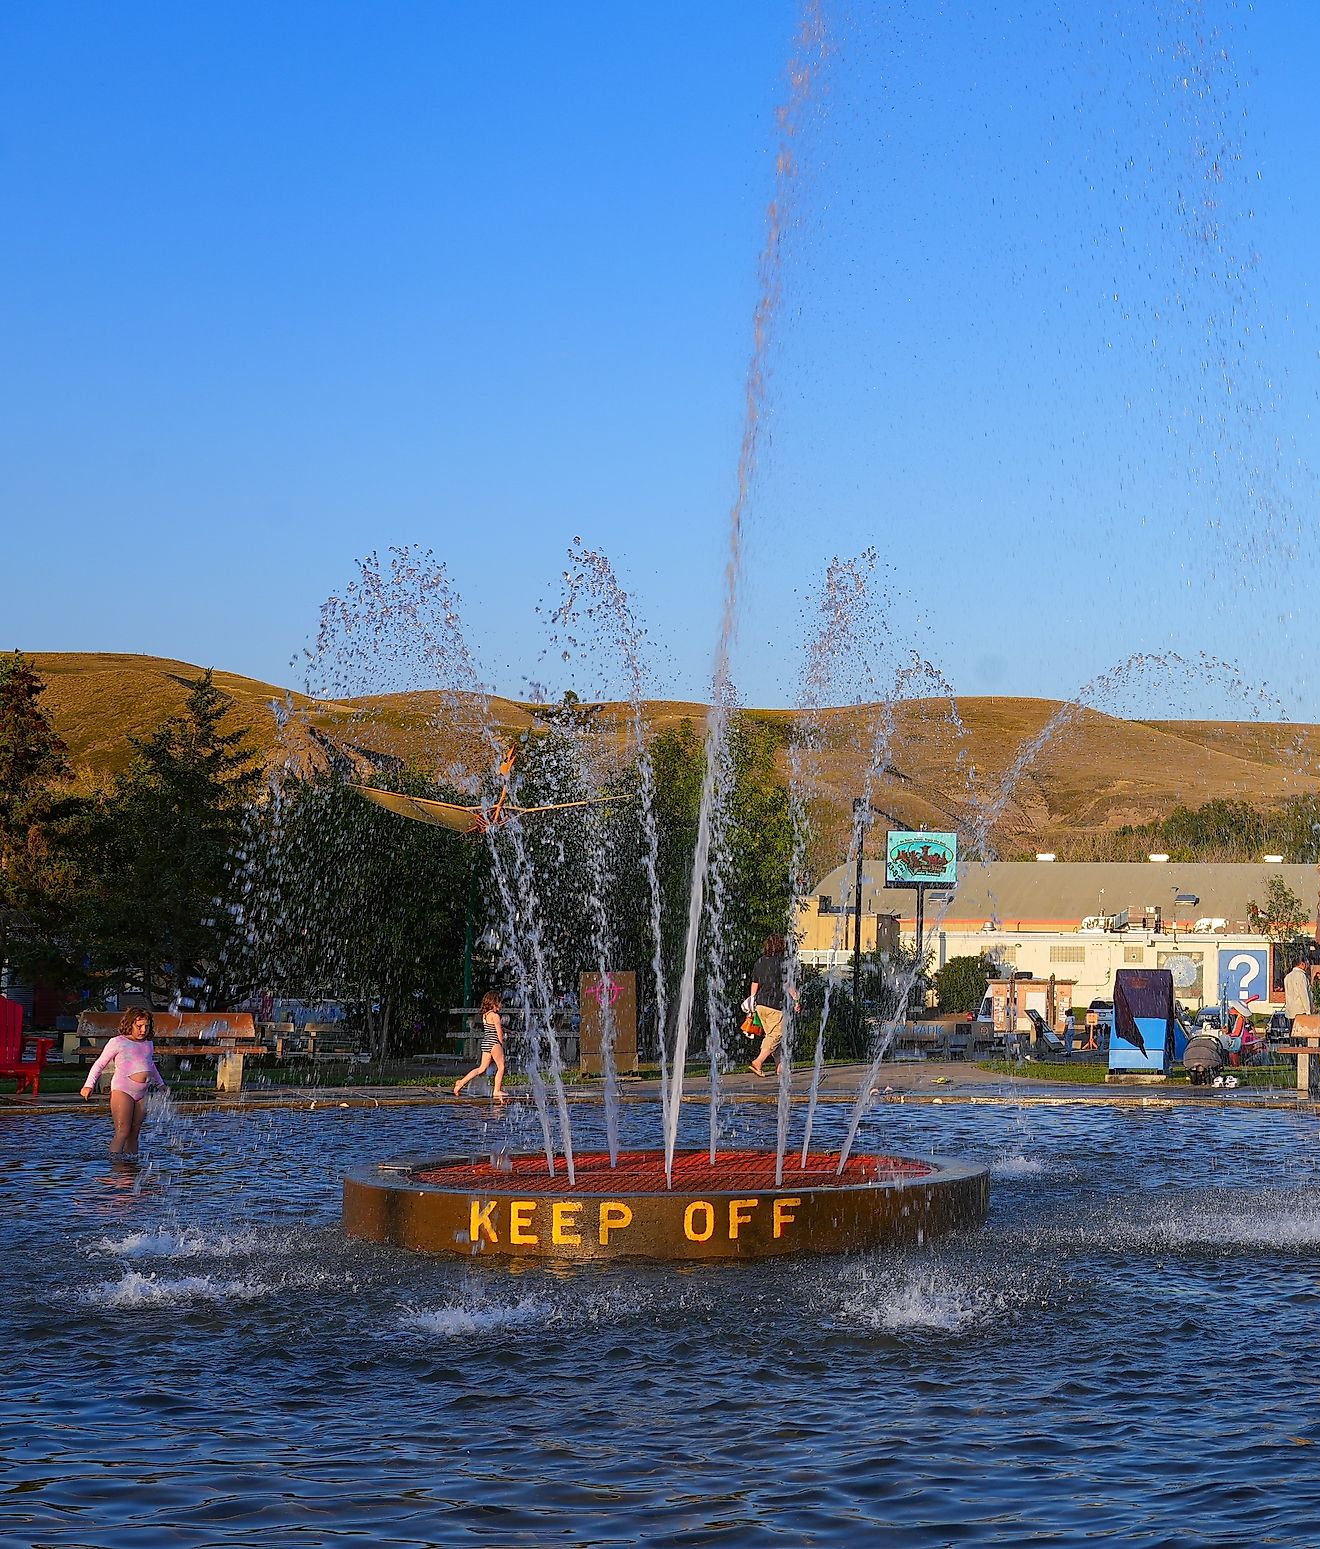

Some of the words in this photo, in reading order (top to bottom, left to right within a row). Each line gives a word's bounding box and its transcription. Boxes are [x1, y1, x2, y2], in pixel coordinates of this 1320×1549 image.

[911, 1024, 944, 1035] PARK
[469, 1200, 633, 1246] KEEP
[683, 1198, 801, 1242] OFF
